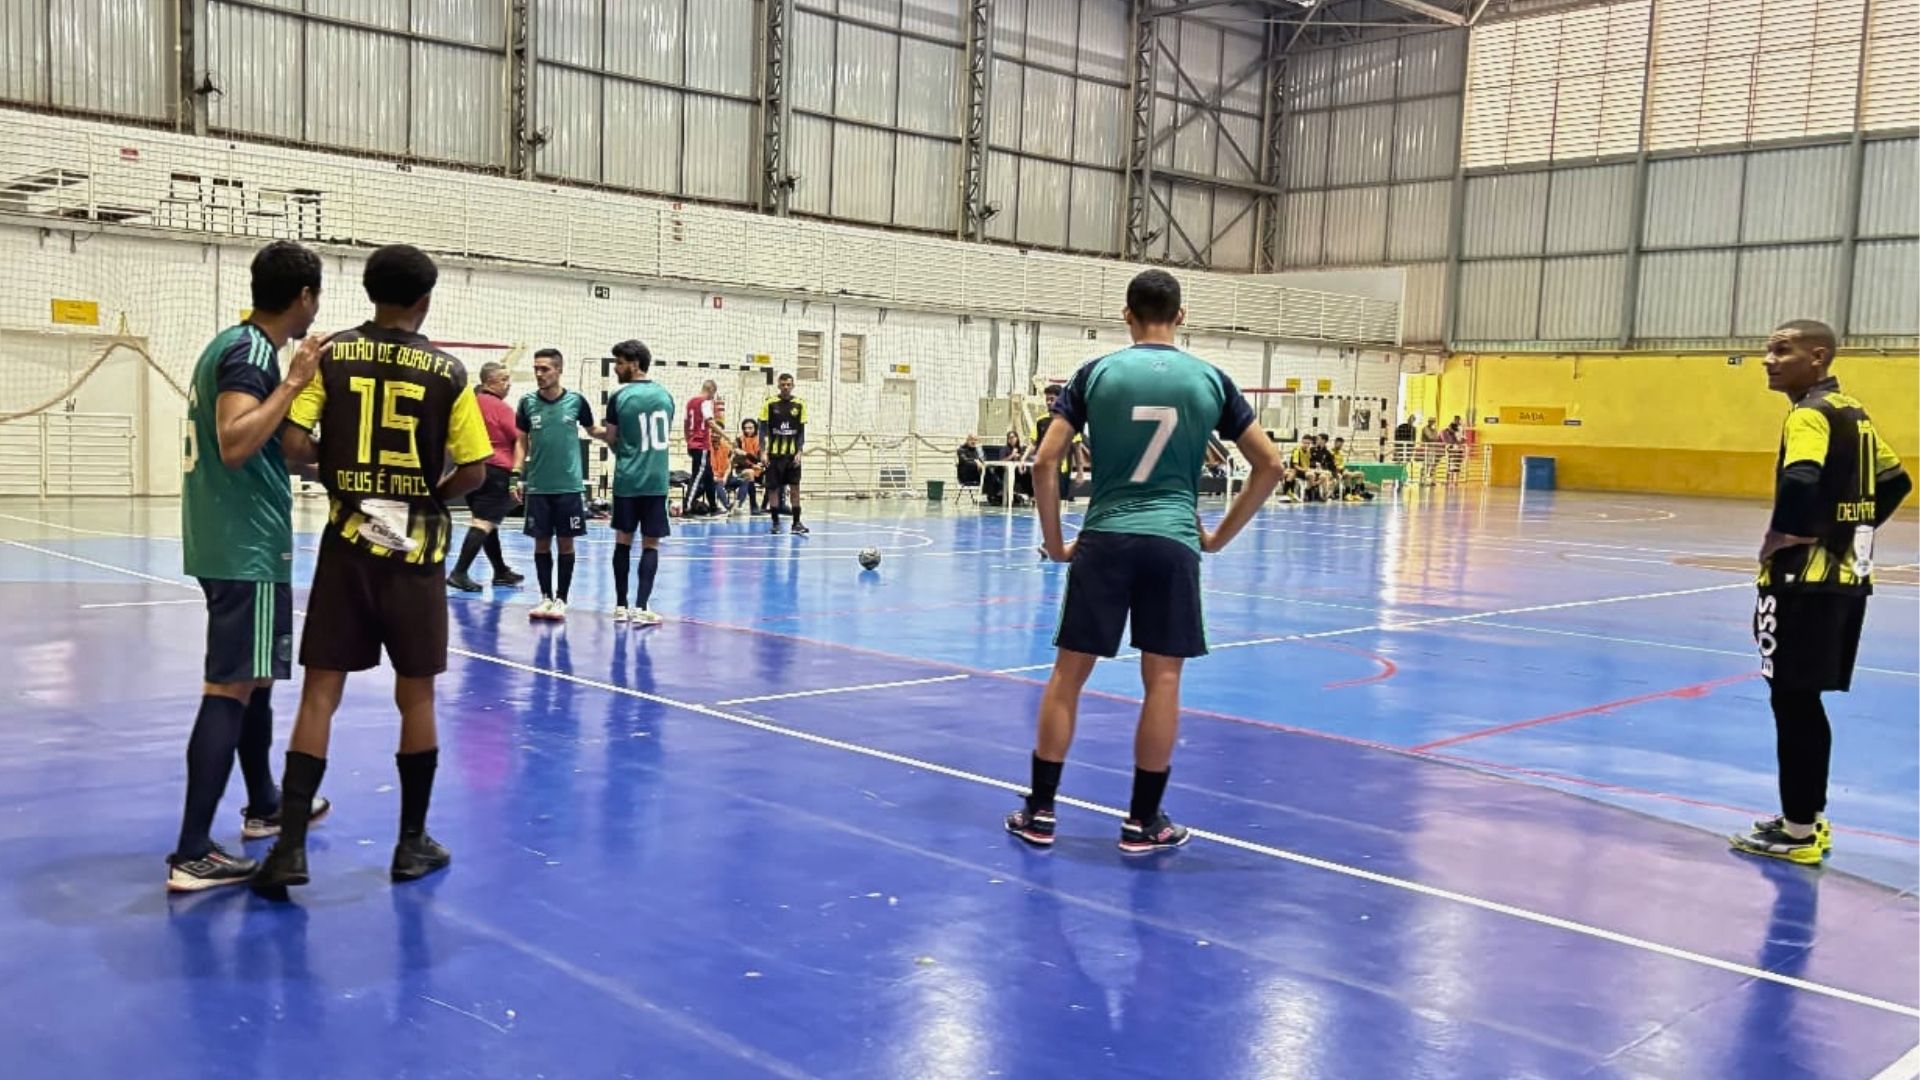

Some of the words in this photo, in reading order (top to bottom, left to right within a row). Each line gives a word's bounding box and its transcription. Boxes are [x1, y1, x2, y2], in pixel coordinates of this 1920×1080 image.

[377, 342, 395, 363] DE
[350, 376, 426, 468] 15
[638, 410, 670, 452] 10
[1130, 406, 1178, 482] 7
[337, 470, 372, 492] DEUS
[377, 468, 386, 493] É
[569, 516, 581, 530] 12
[1757, 594, 1777, 678] BOSS
